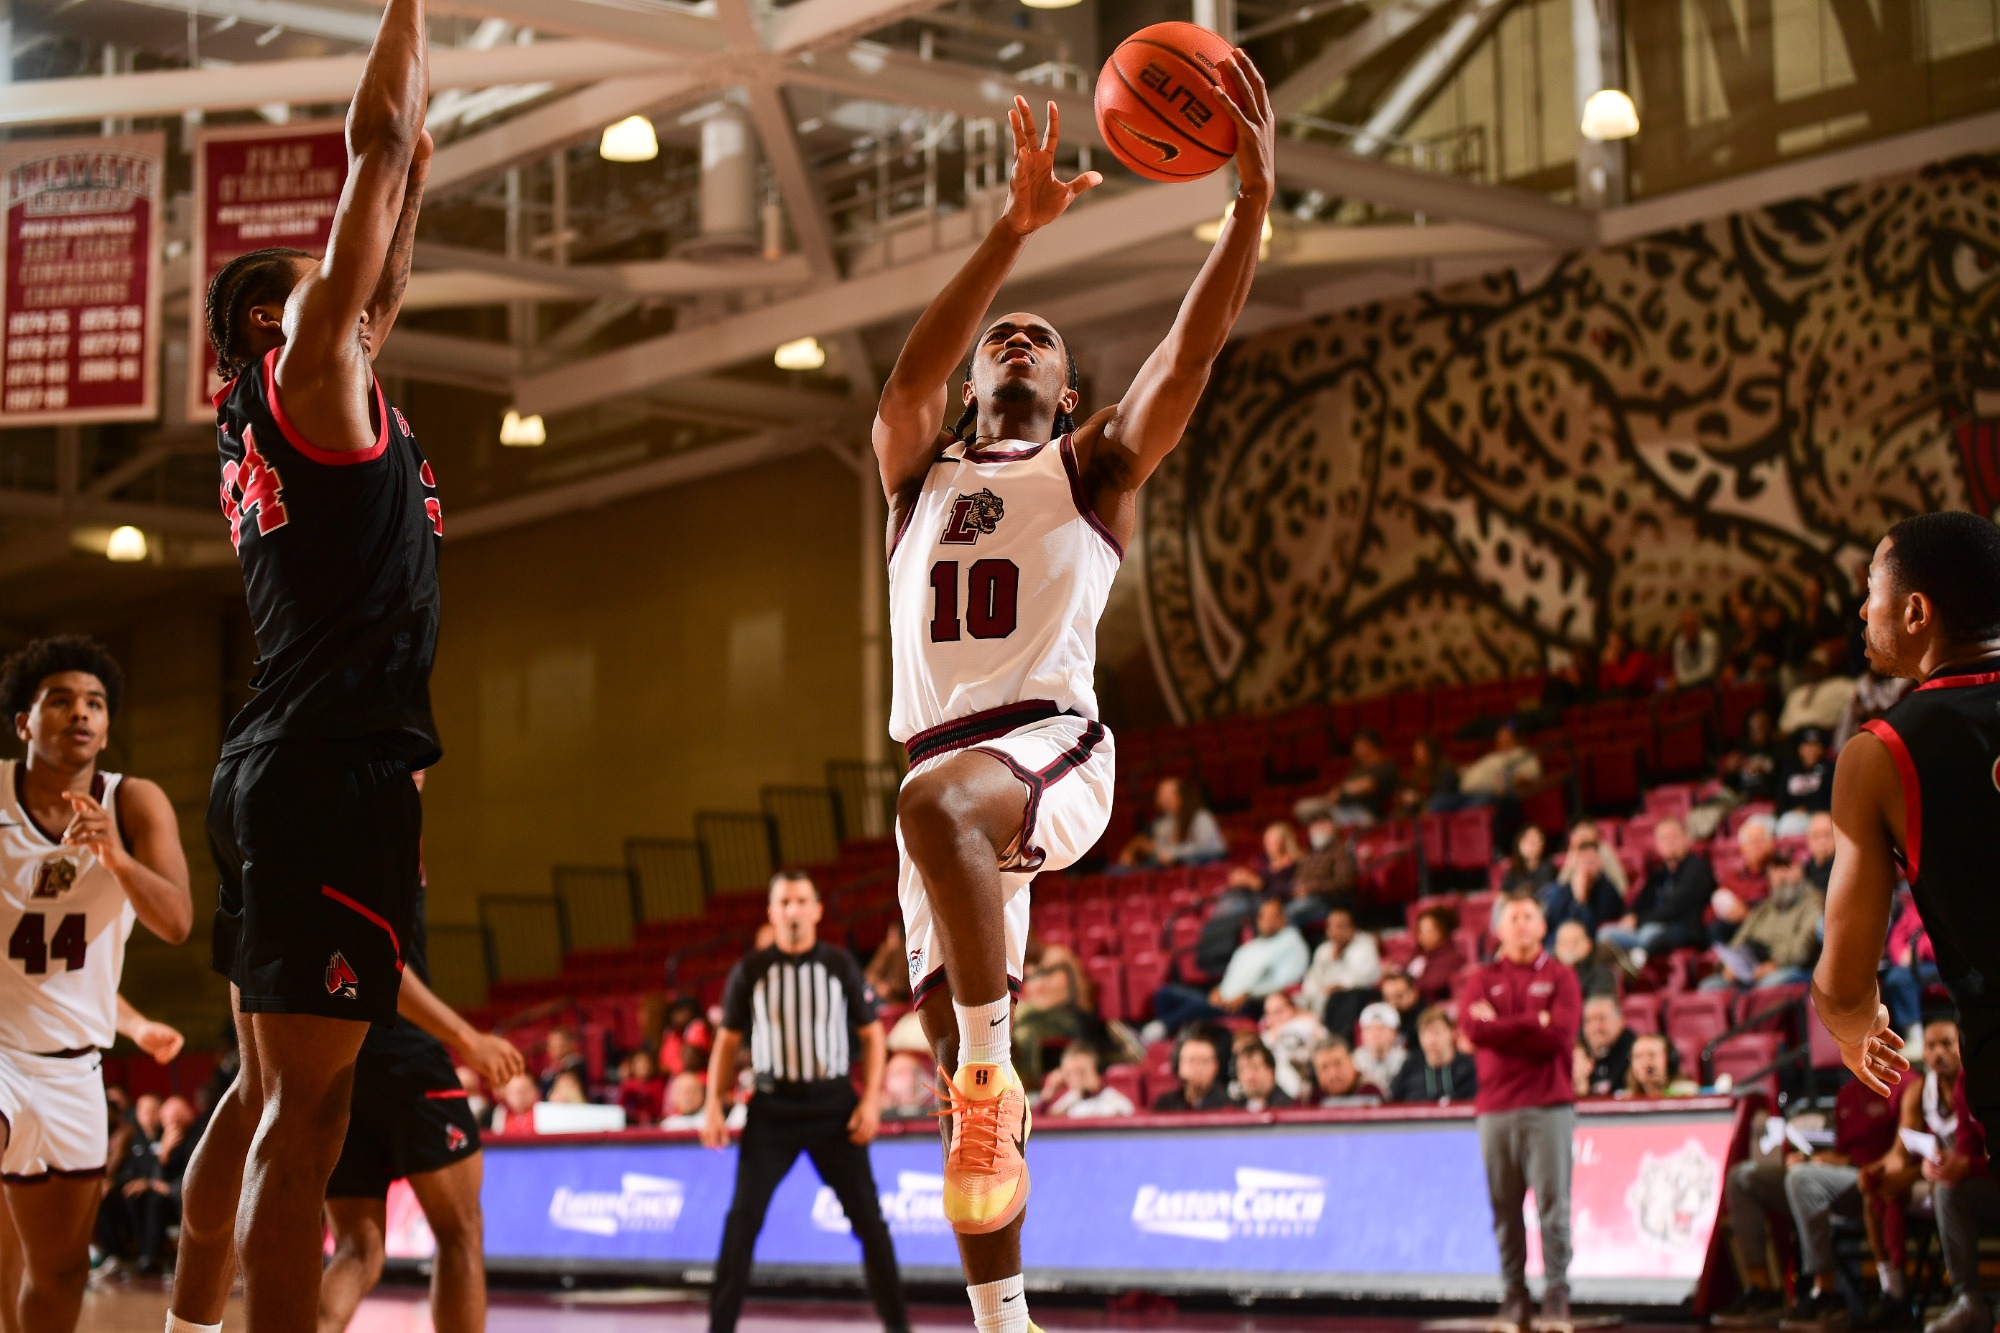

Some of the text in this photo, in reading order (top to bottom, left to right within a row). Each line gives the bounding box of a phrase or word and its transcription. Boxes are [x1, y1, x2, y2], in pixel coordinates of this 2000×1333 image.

[1138, 62, 1213, 130] ELITE
[939, 498, 980, 545] L
[930, 558, 1019, 643] 10
[9, 912, 87, 974] 44
